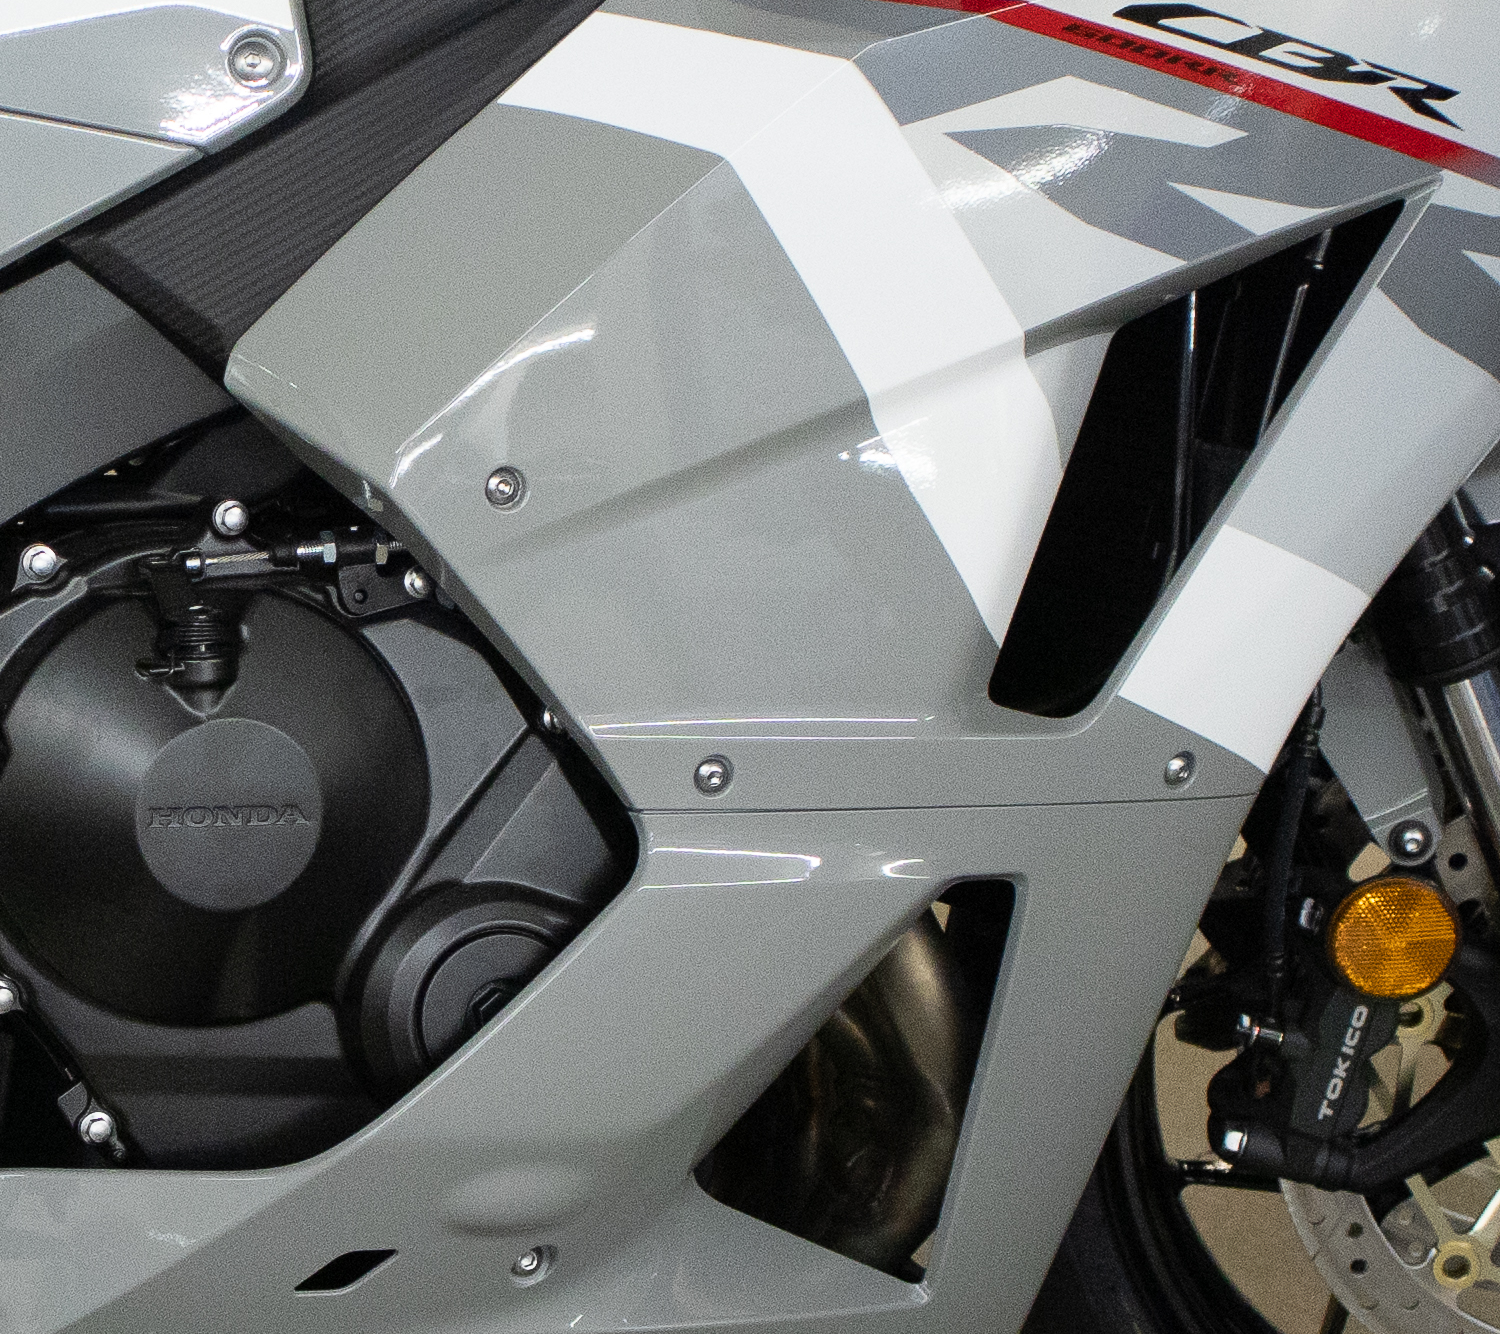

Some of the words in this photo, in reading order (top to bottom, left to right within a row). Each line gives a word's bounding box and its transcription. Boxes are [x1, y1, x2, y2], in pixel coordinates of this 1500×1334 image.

[1062, 23, 1240, 84] 600RR
[1112, 3, 1465, 132] CBR
[146, 802, 310, 829] HONDA
[1316, 1003, 1371, 1122] TOKICO
